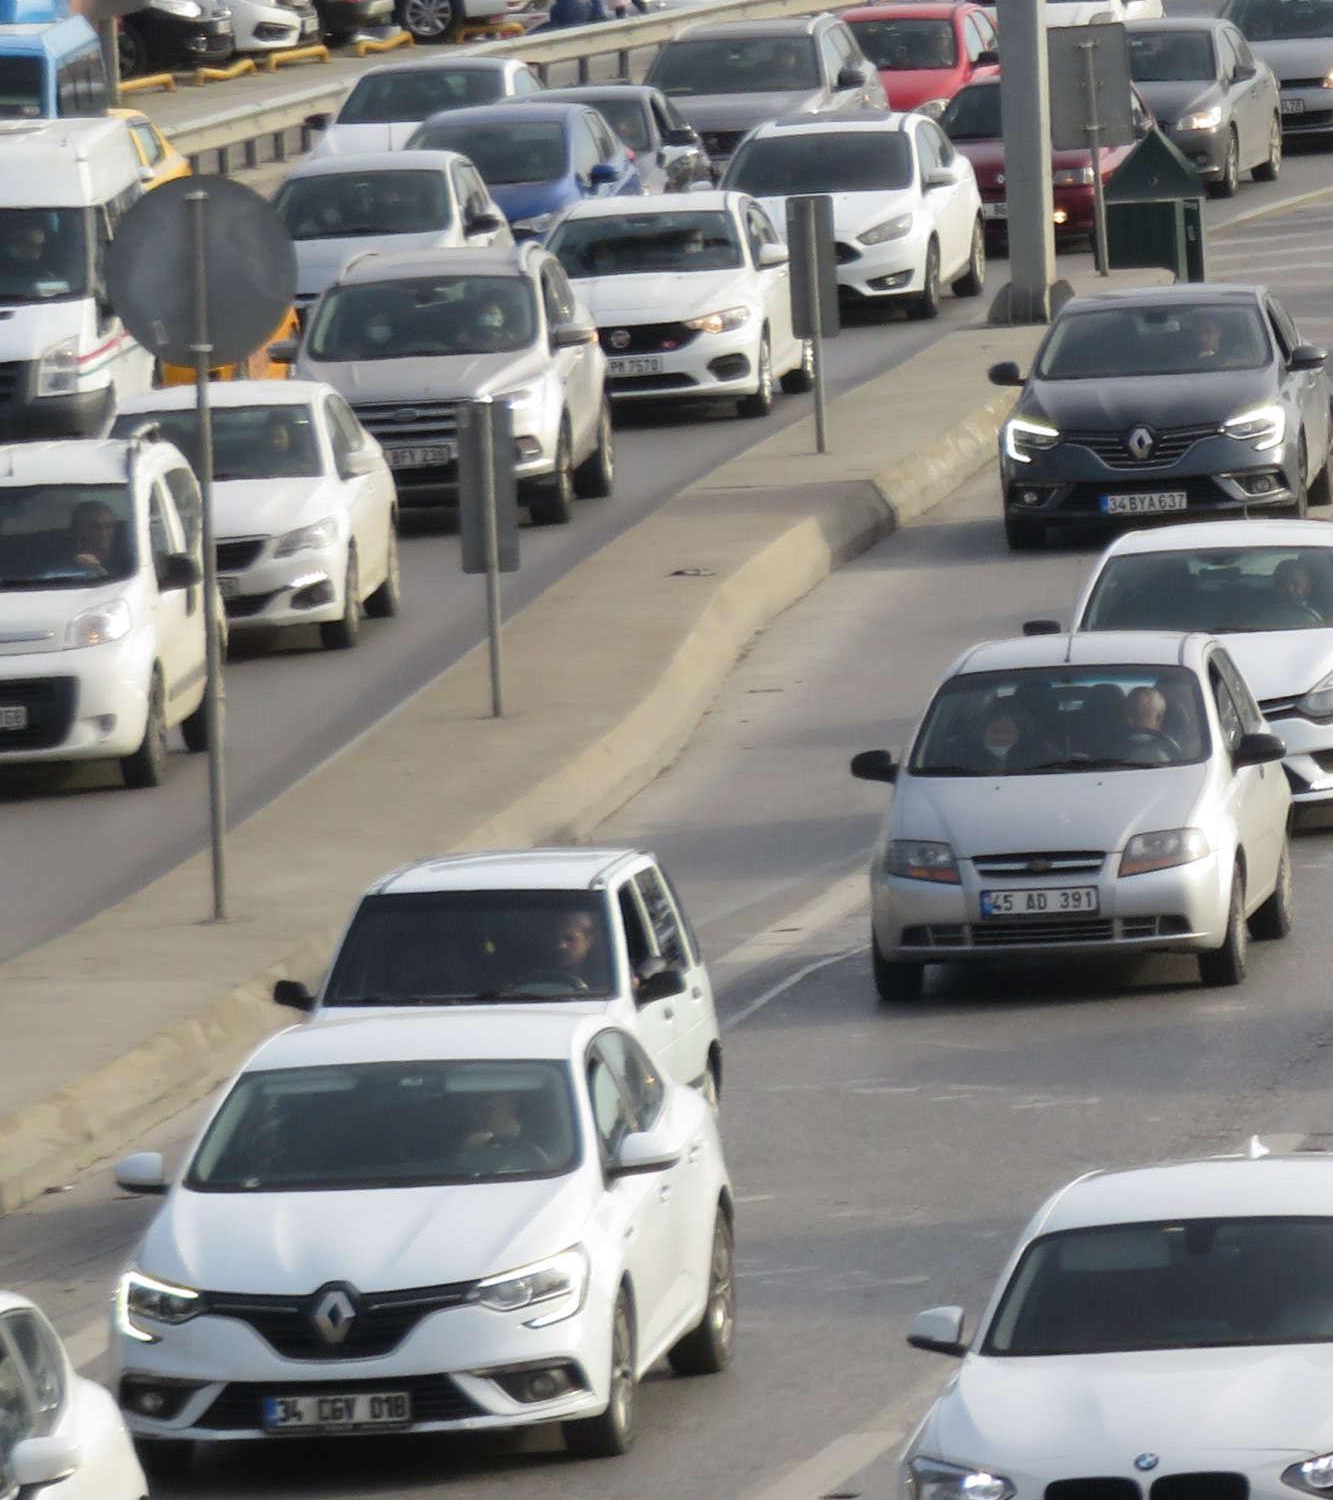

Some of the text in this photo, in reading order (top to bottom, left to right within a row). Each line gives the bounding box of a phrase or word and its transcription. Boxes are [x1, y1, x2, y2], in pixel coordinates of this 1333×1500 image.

[1110, 494, 1185, 511] 34 BYA 637
[992, 891, 1092, 911] 45 AD 391
[278, 1401, 303, 1422] 34
